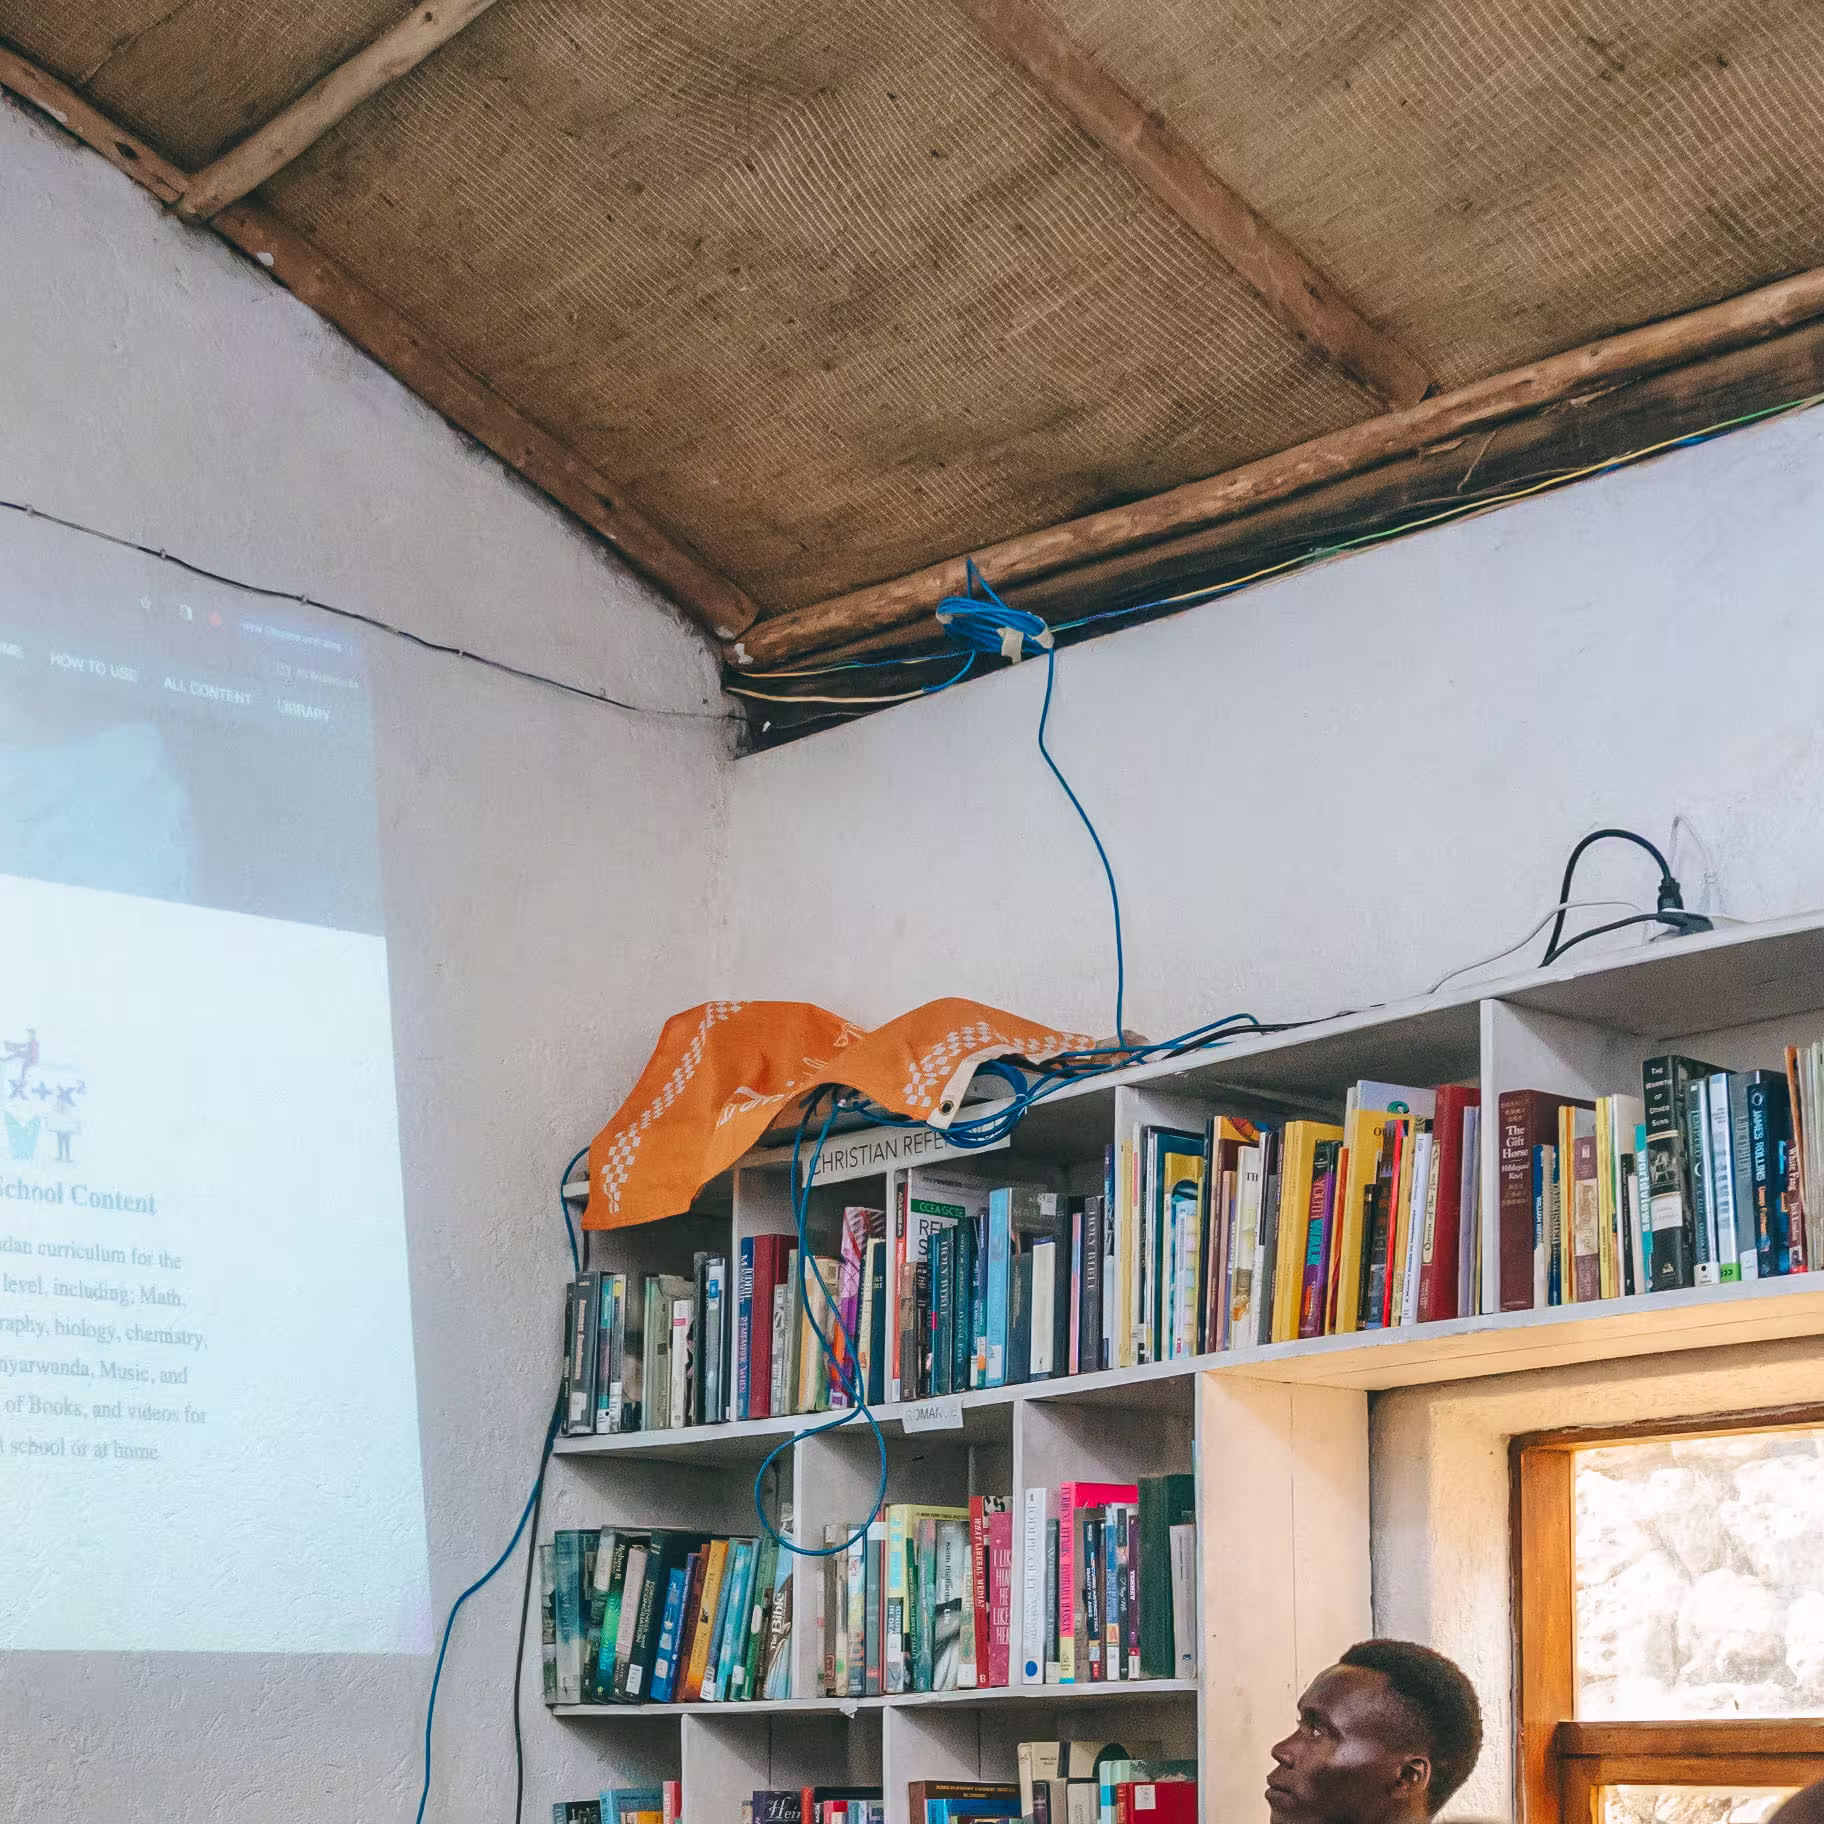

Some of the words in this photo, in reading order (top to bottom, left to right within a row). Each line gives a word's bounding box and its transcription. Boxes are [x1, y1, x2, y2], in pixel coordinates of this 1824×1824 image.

[50, 652, 84, 672] HOW
[88, 658, 106, 675] TO
[110, 663, 139, 683] USE
[164, 677, 186, 693] ALL
[190, 681, 252, 705] CONTENT
[277, 700, 330, 722] LIBRARY
[1505, 1124, 1525, 1137] The
[1752, 1110, 1764, 1140] JAMES
[811, 1136, 899, 1176] CHRISTIAN
[1502, 1147, 1529, 1159] Horse
[1505, 1136, 1524, 1149] Gift
[1755, 1142, 1766, 1182] ROLLINS
[71, 1184, 158, 1216] Content
[1638, 1150, 1650, 1232] worldviews
[38, 1239, 126, 1265] curriculum
[131, 1246, 153, 1267] for
[158, 1251, 182, 1271] the
[55, 1320, 121, 1344] biology,
[125, 1327, 208, 1352] chemistry,
[160, 1366, 188, 1386] and
[6, 1395, 25, 1415] of
[92, 1402, 122, 1420] and
[128, 1405, 178, 1423] videos
[184, 1406, 207, 1425] for
[10, 1438, 65, 1458] school
[71, 1443, 87, 1459] or
[94, 1442, 108, 1460] at
[114, 1442, 158, 1462] home
[771, 1592, 786, 1634] Bible
